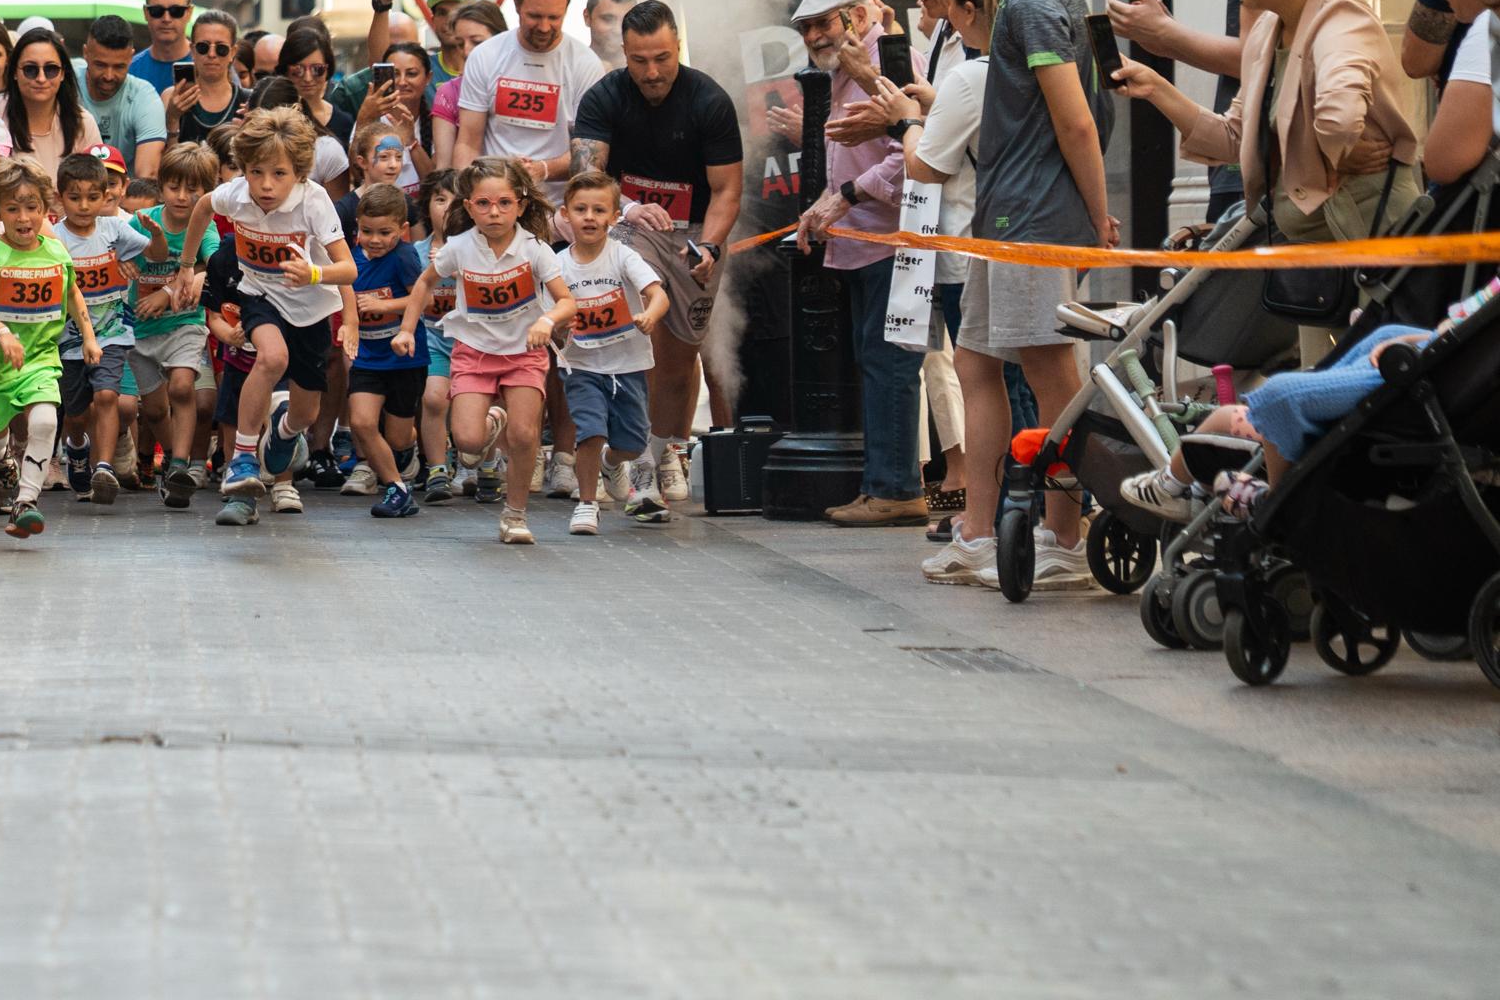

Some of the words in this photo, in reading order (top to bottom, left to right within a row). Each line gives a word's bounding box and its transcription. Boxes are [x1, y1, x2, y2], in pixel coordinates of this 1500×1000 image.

[507, 91, 546, 113] 235
[623, 175, 691, 191] CORREFAMILY
[244, 241, 291, 265] 360
[465, 263, 531, 285] CORREFAMILY
[582, 279, 593, 288] ON
[594, 278, 623, 288] WHEELS
[10, 281, 53, 304] 336
[478, 282, 520, 306] 361
[576, 307, 618, 332] 342
